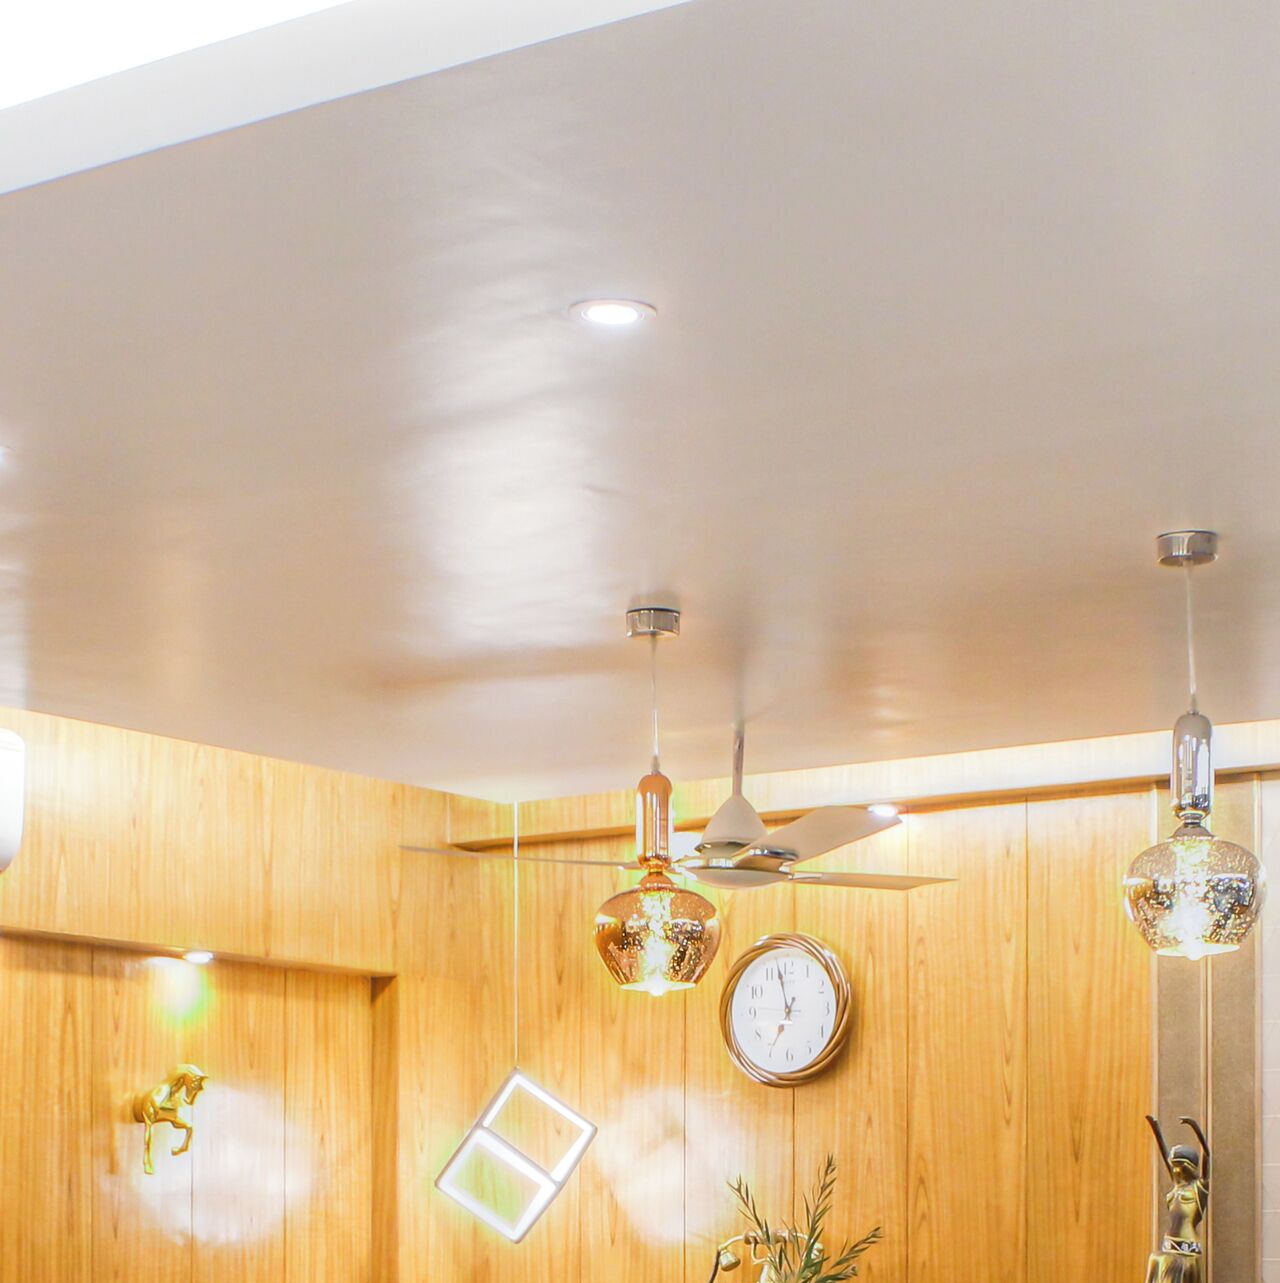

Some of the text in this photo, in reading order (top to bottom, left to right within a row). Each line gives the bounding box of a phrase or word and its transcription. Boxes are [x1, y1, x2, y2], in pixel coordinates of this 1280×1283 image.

[765, 967, 774, 981] 11
[783, 961, 794, 976] 12
[751, 985, 763, 999] 10
[818, 979, 825, 994] 2
[749, 1007, 757, 1019] 9
[754, 1029, 761, 1041] 8
[785, 1047, 794, 1063] 6
